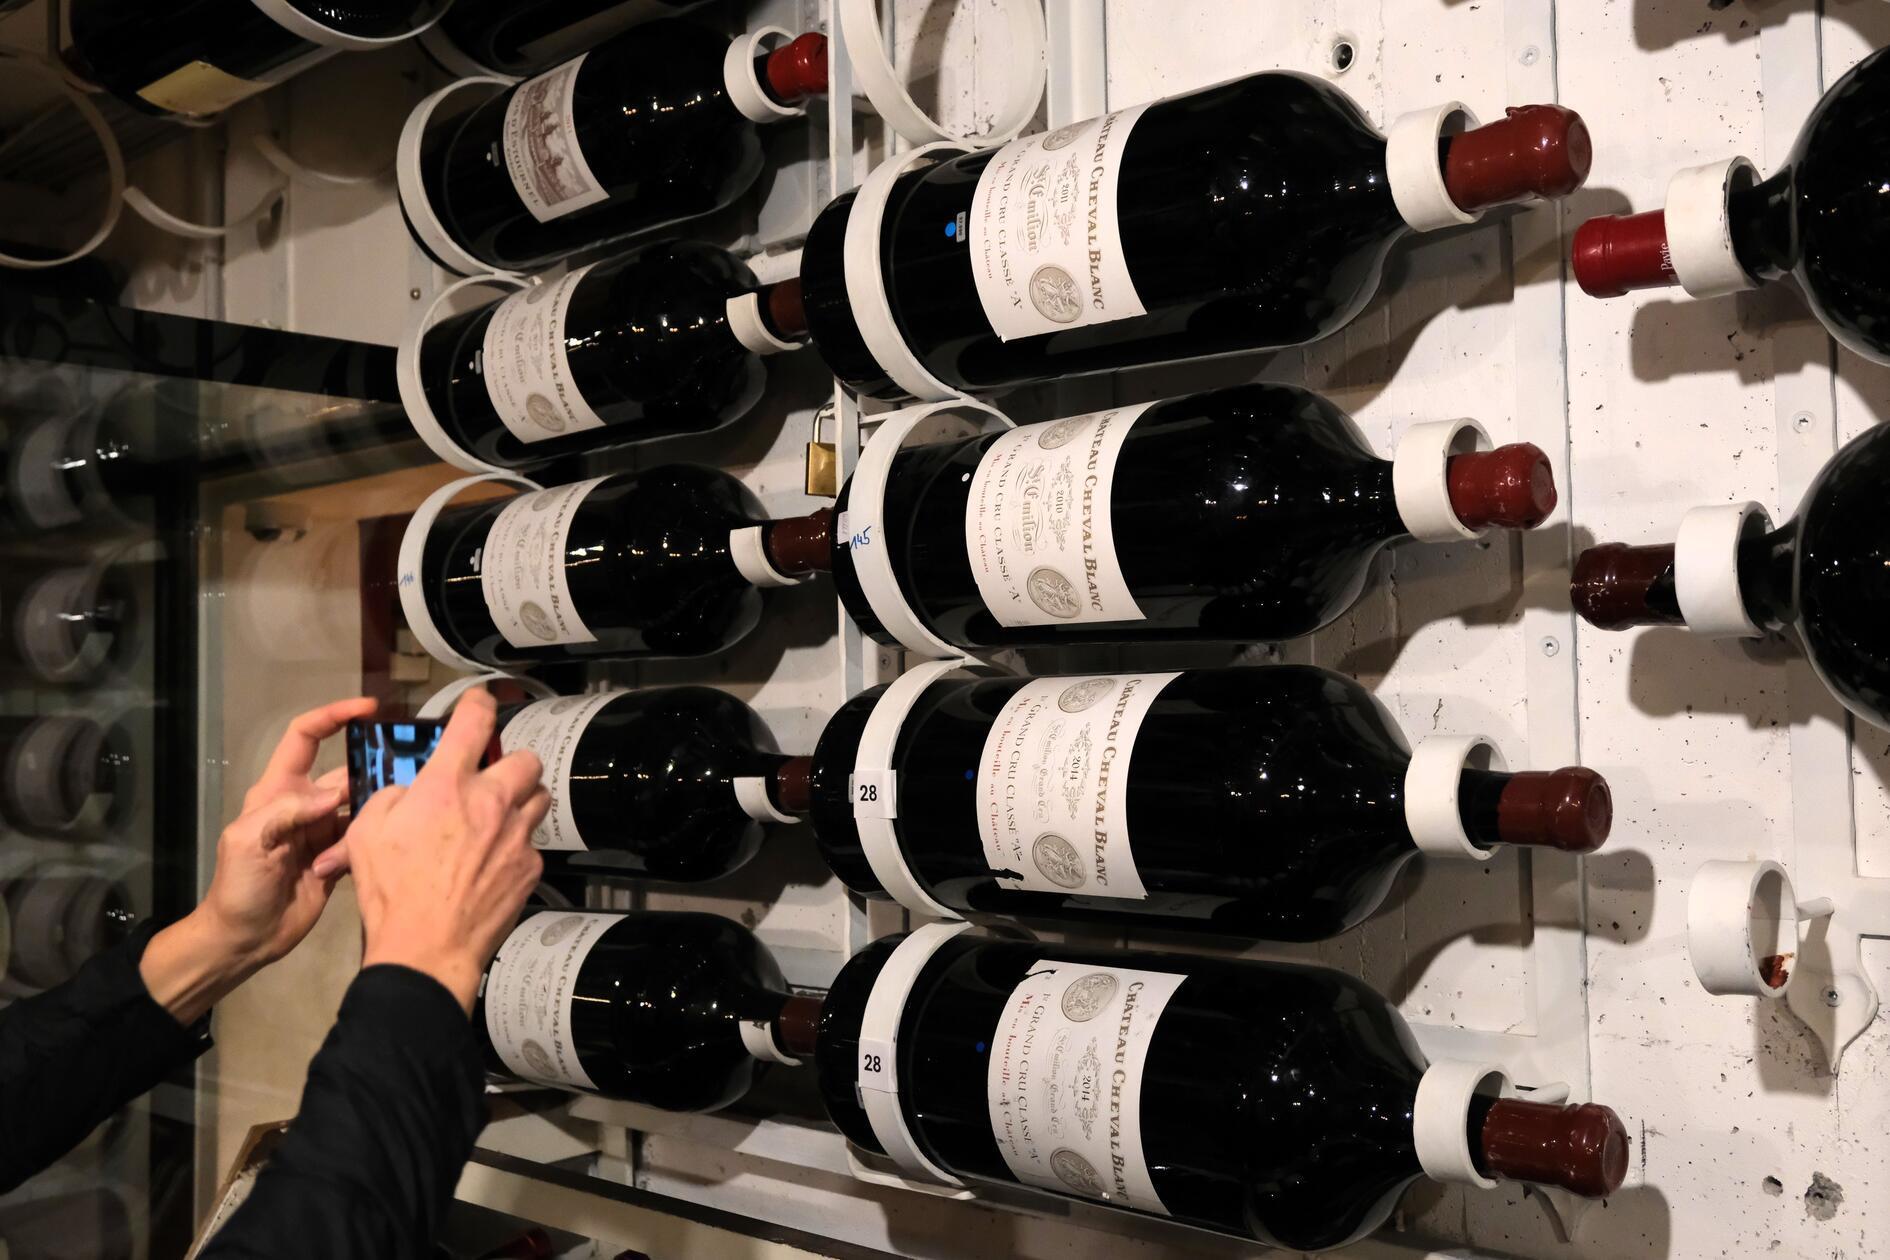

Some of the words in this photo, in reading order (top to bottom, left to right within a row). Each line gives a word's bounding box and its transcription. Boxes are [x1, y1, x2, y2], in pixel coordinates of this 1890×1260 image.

[1003, 150, 1025, 192] GRAND
[1060, 184, 1069, 203] 2011
[999, 195, 1008, 224] CRU
[1088, 167, 1105, 245] CHEVAL
[1088, 249, 1105, 310] BLANC
[1660, 242, 1673, 271] Pavie
[549, 320, 559, 379] CHEVAL
[556, 383, 578, 423] BLANC
[1087, 411, 1119, 470] CHÂTEAU
[999, 445, 1023, 488] GRAND
[994, 492, 1004, 522] CRU
[1056, 490, 1065, 514] 2010
[1082, 475, 1097, 554] CHEVAL
[850, 525, 872, 550] 145
[548, 532, 559, 591] CHEVAL
[1085, 558, 1104, 612] BLANC
[551, 594, 570, 635] BLANC
[1015, 704, 1042, 746] GRAND
[1107, 679, 1143, 741] CHÂTEAU
[551, 736, 571, 794] CHEVAL
[991, 730, 1010, 778] bouteille
[1007, 751, 1020, 780] CRU
[1069, 755, 1081, 781] 2014
[859, 784, 878, 802] 28
[1095, 746, 1116, 826] CHEVAL
[551, 798, 563, 842] BLANC
[1095, 830, 1108, 886] BLANC
[553, 976, 567, 1037] CHEVAL
[1017, 993, 1034, 1014] Mis
[1114, 982, 1144, 1064] CHÂTEAU
[1022, 1005, 1045, 1055] GRAND
[864, 1053, 882, 1073] 28
[1001, 1034, 1017, 1086] bouteille
[1017, 1060, 1029, 1091] CRU
[1081, 1075, 1092, 1102] 2014
[1110, 1069, 1126, 1148] CHEVAL
[1111, 1152, 1129, 1200] BLANC
